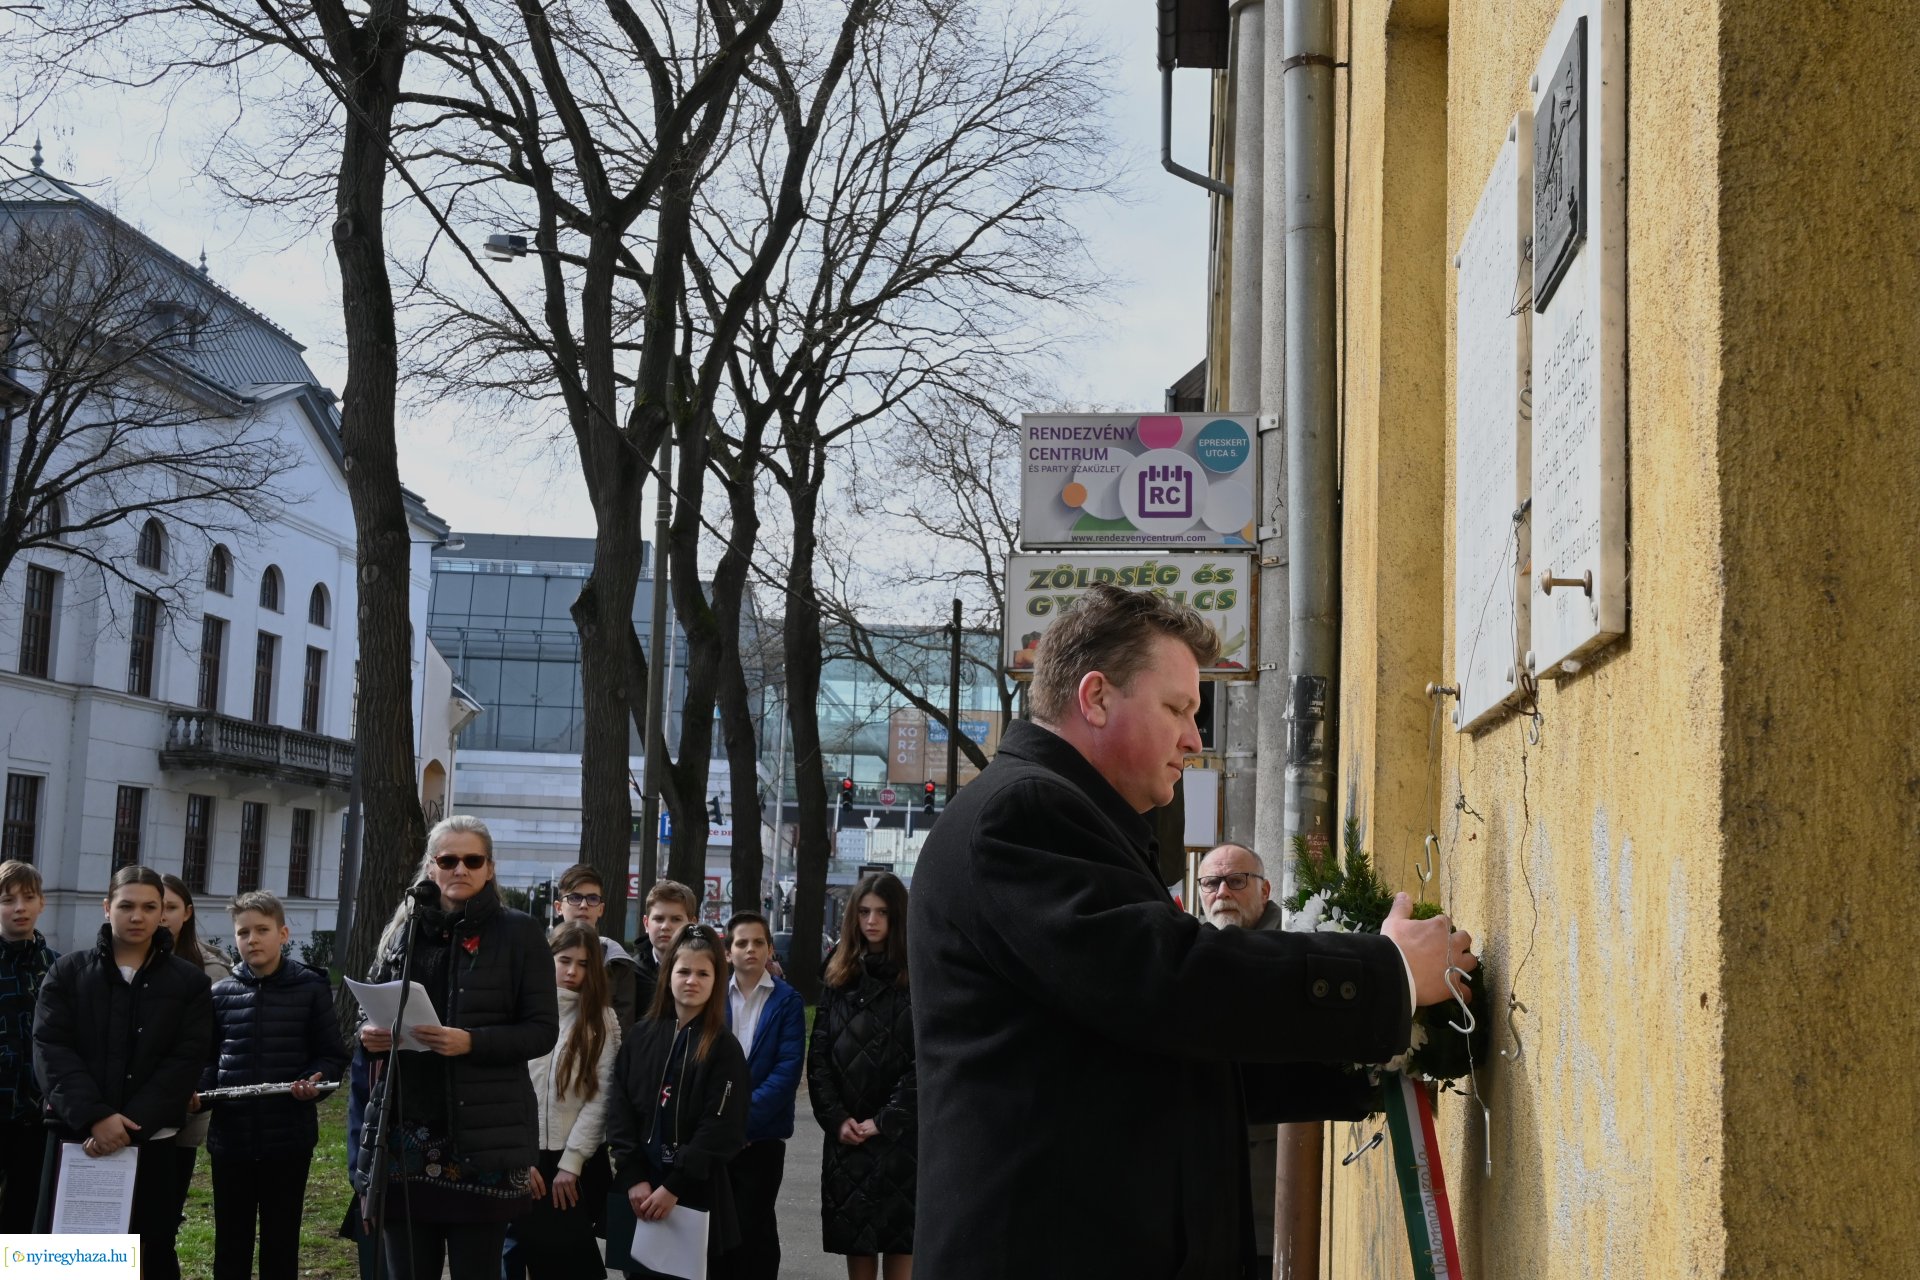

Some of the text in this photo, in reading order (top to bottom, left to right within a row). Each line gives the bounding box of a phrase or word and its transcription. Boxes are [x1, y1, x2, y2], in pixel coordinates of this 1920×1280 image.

[1029, 423, 1135, 441] RENDEZVÉNY
[1199, 438, 1248, 447] EPRESKERT
[1029, 447, 1108, 461] CENTRUM
[1205, 449, 1238, 457] UTCA 5.
[1029, 463, 1120, 473] ÉS PARTY SZAKÜZLET
[1150, 486, 1181, 505] RC
[1071, 533, 1206, 544] www.rendezvenycentrum.com
[1025, 560, 1235, 591] ZÖLDSÉG és
